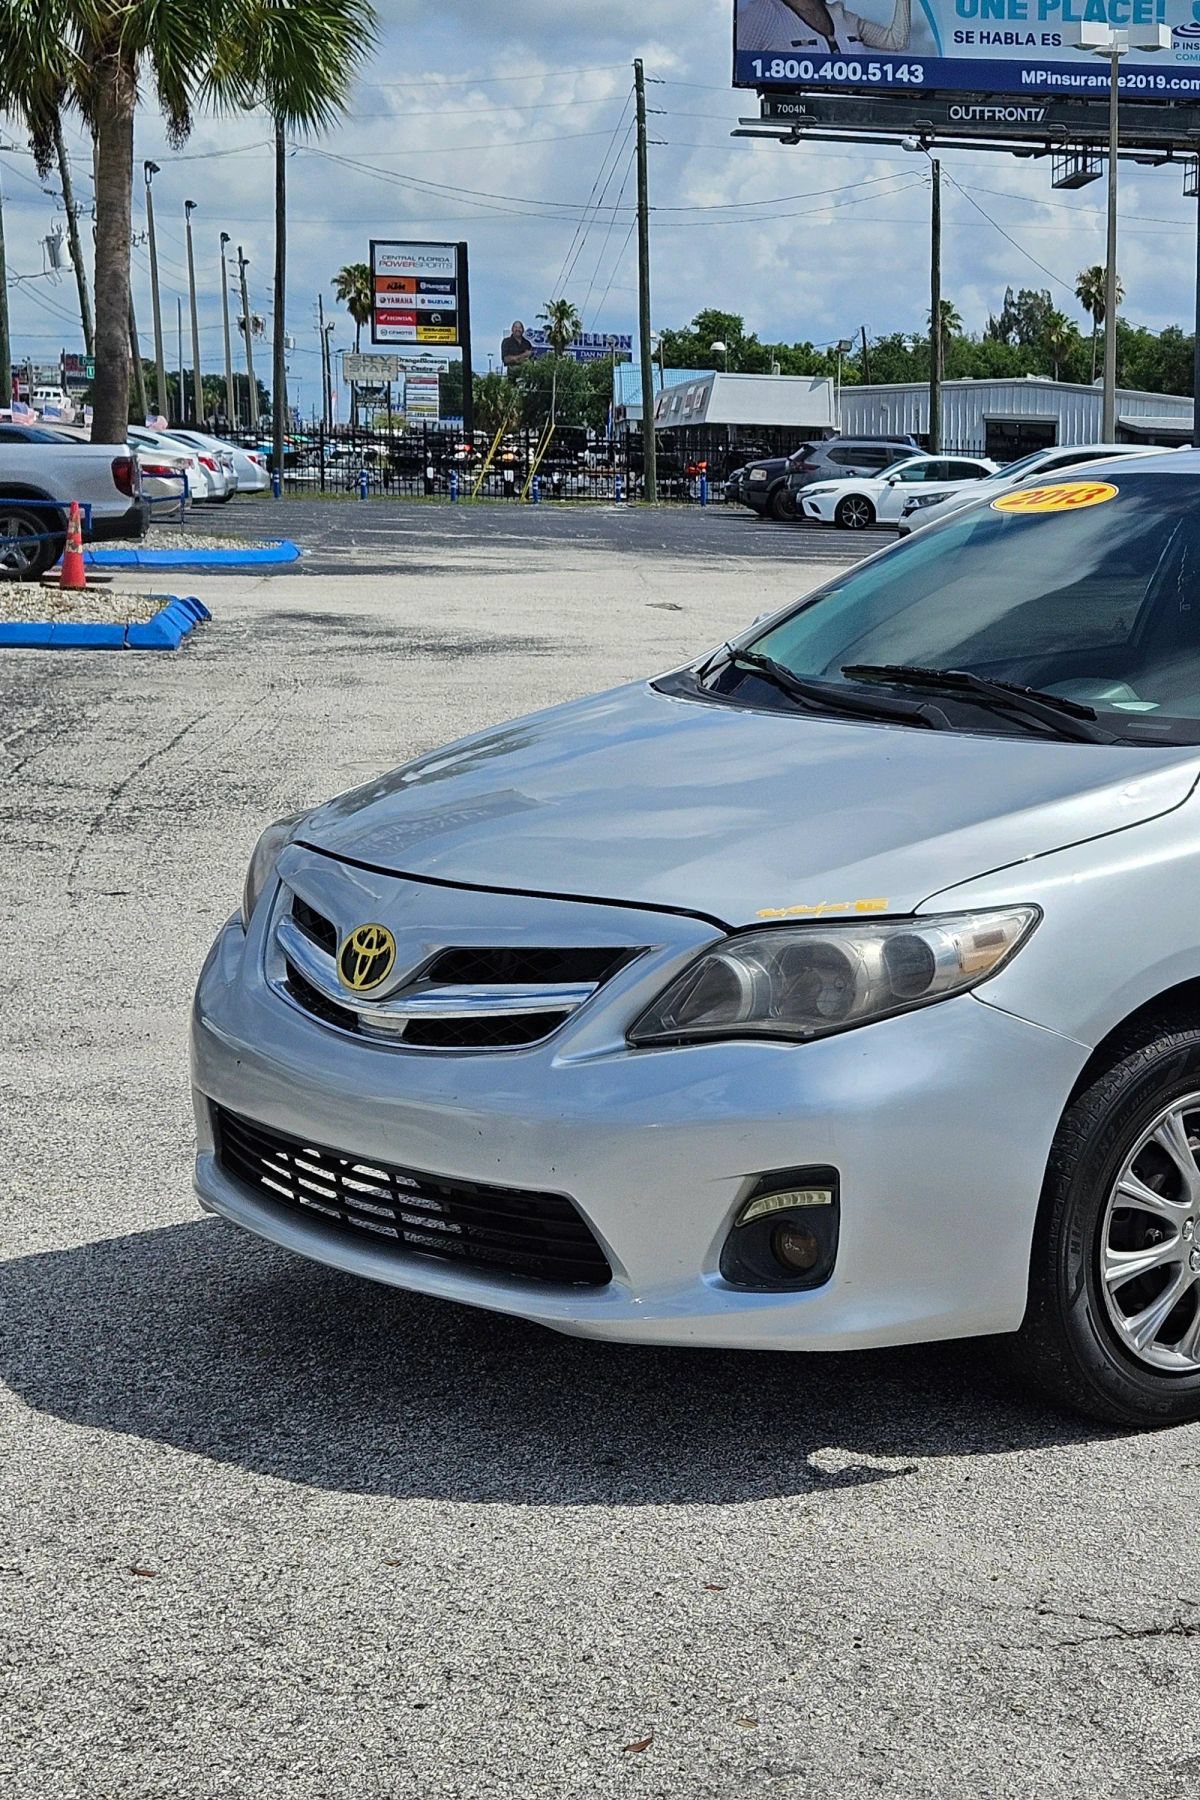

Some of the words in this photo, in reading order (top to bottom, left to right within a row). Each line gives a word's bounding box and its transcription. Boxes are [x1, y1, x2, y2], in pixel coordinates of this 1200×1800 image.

[1038, 0, 1165, 24] PLACE!
[953, 30, 975, 44] SE
[979, 31, 1037, 46] HABLA
[751, 58, 925, 84] 1.800.400.5143
[776, 103, 806, 114] 7004N
[381, 254, 417, 262] CENTRAL
[417, 255, 450, 263] FLORIDA
[378, 260, 453, 270] POWERSPORTS
[387, 297, 414, 305] YAMAHA
[349, 355, 392, 365] CITY
[349, 364, 392, 373] STAR
[1000, 487, 1108, 506] 2013
